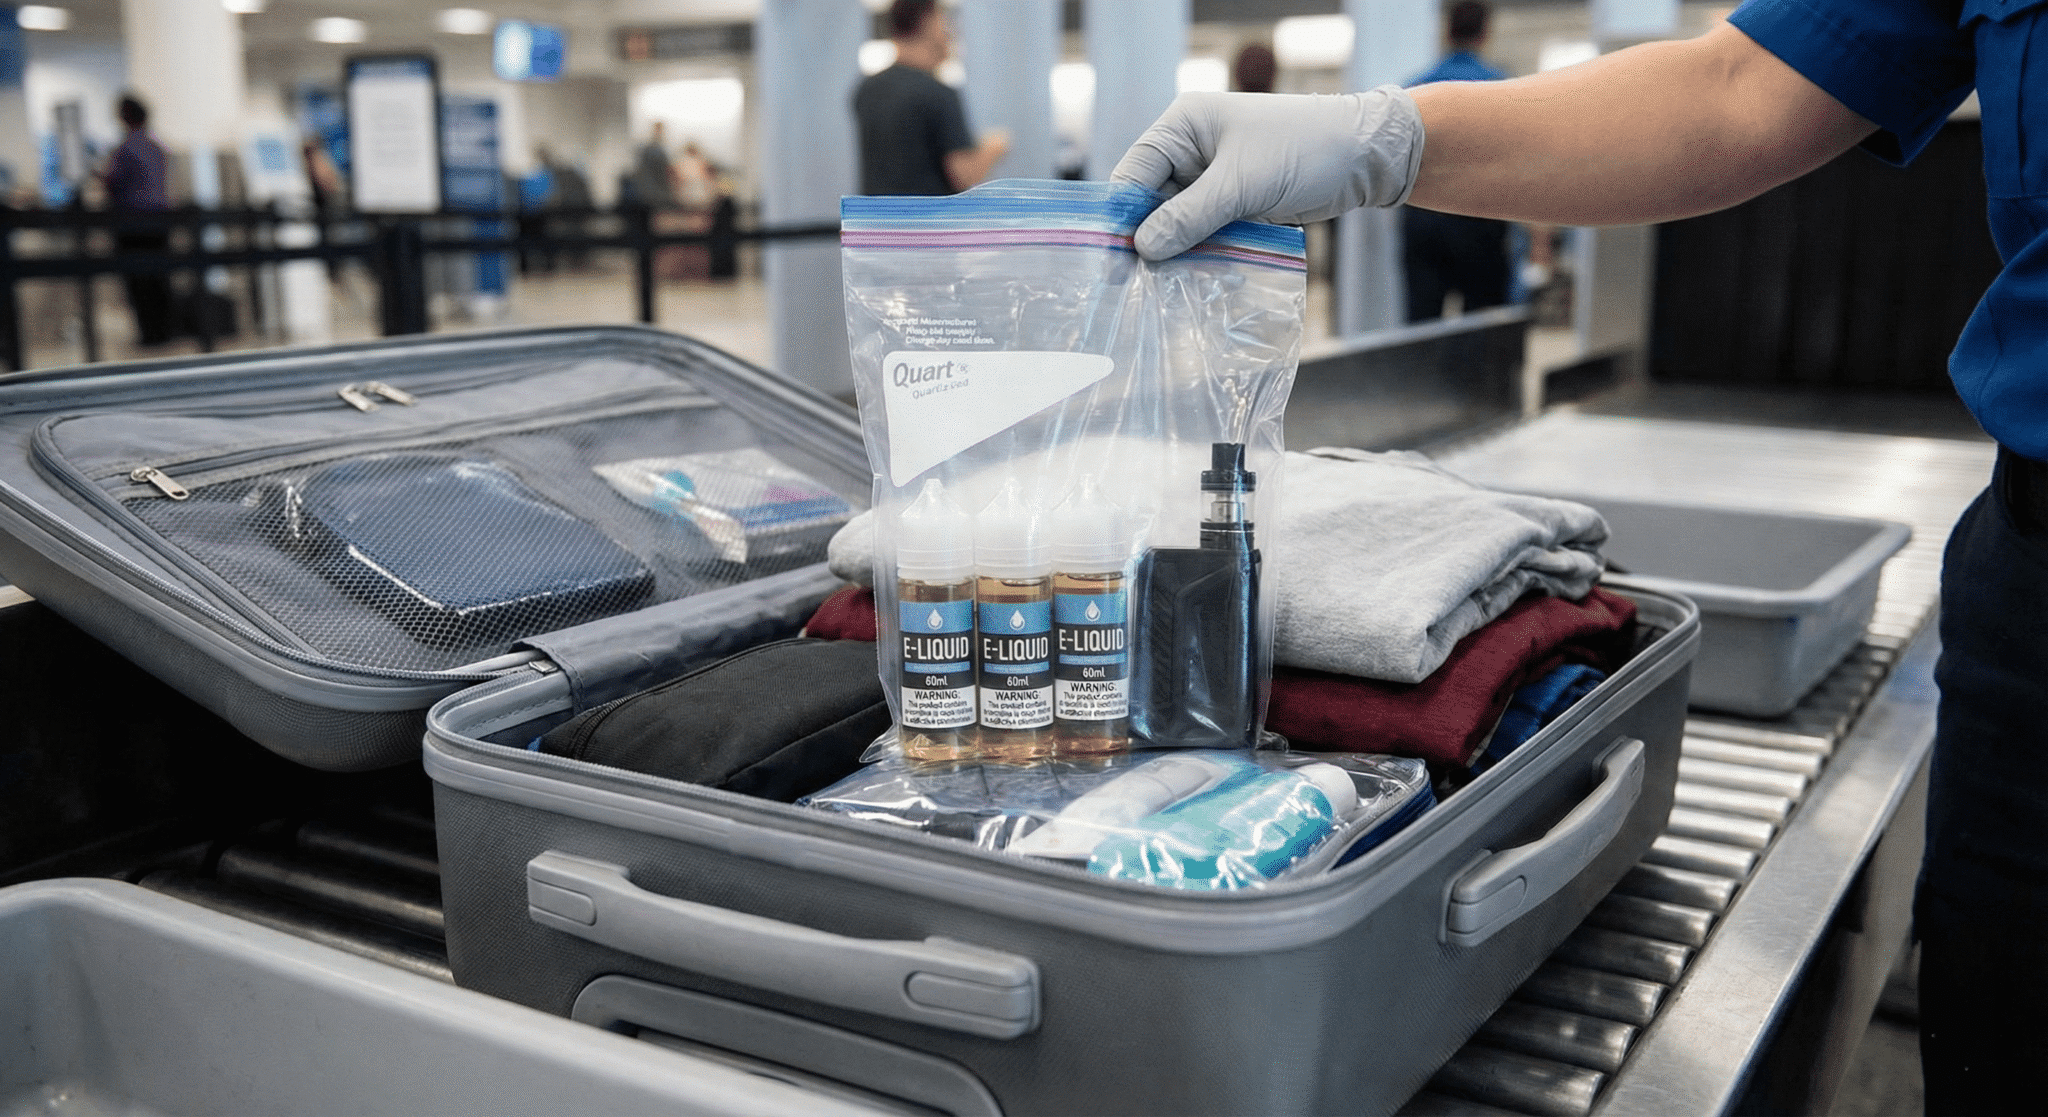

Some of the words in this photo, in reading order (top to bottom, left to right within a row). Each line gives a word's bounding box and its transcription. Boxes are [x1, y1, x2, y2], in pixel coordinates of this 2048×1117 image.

[893, 361, 954, 388] Quart
[1059, 628, 1124, 652] E-LIQUID
[903, 636, 969, 660] E-LIQUID
[983, 636, 1049, 661] E-LIQUID
[1082, 666, 1106, 678] 60ml
[925, 675, 948, 686] 60ml
[1006, 675, 1029, 687] 60ml
[914, 690, 961, 700] WARNING:
[995, 690, 1042, 701] WARNING:
